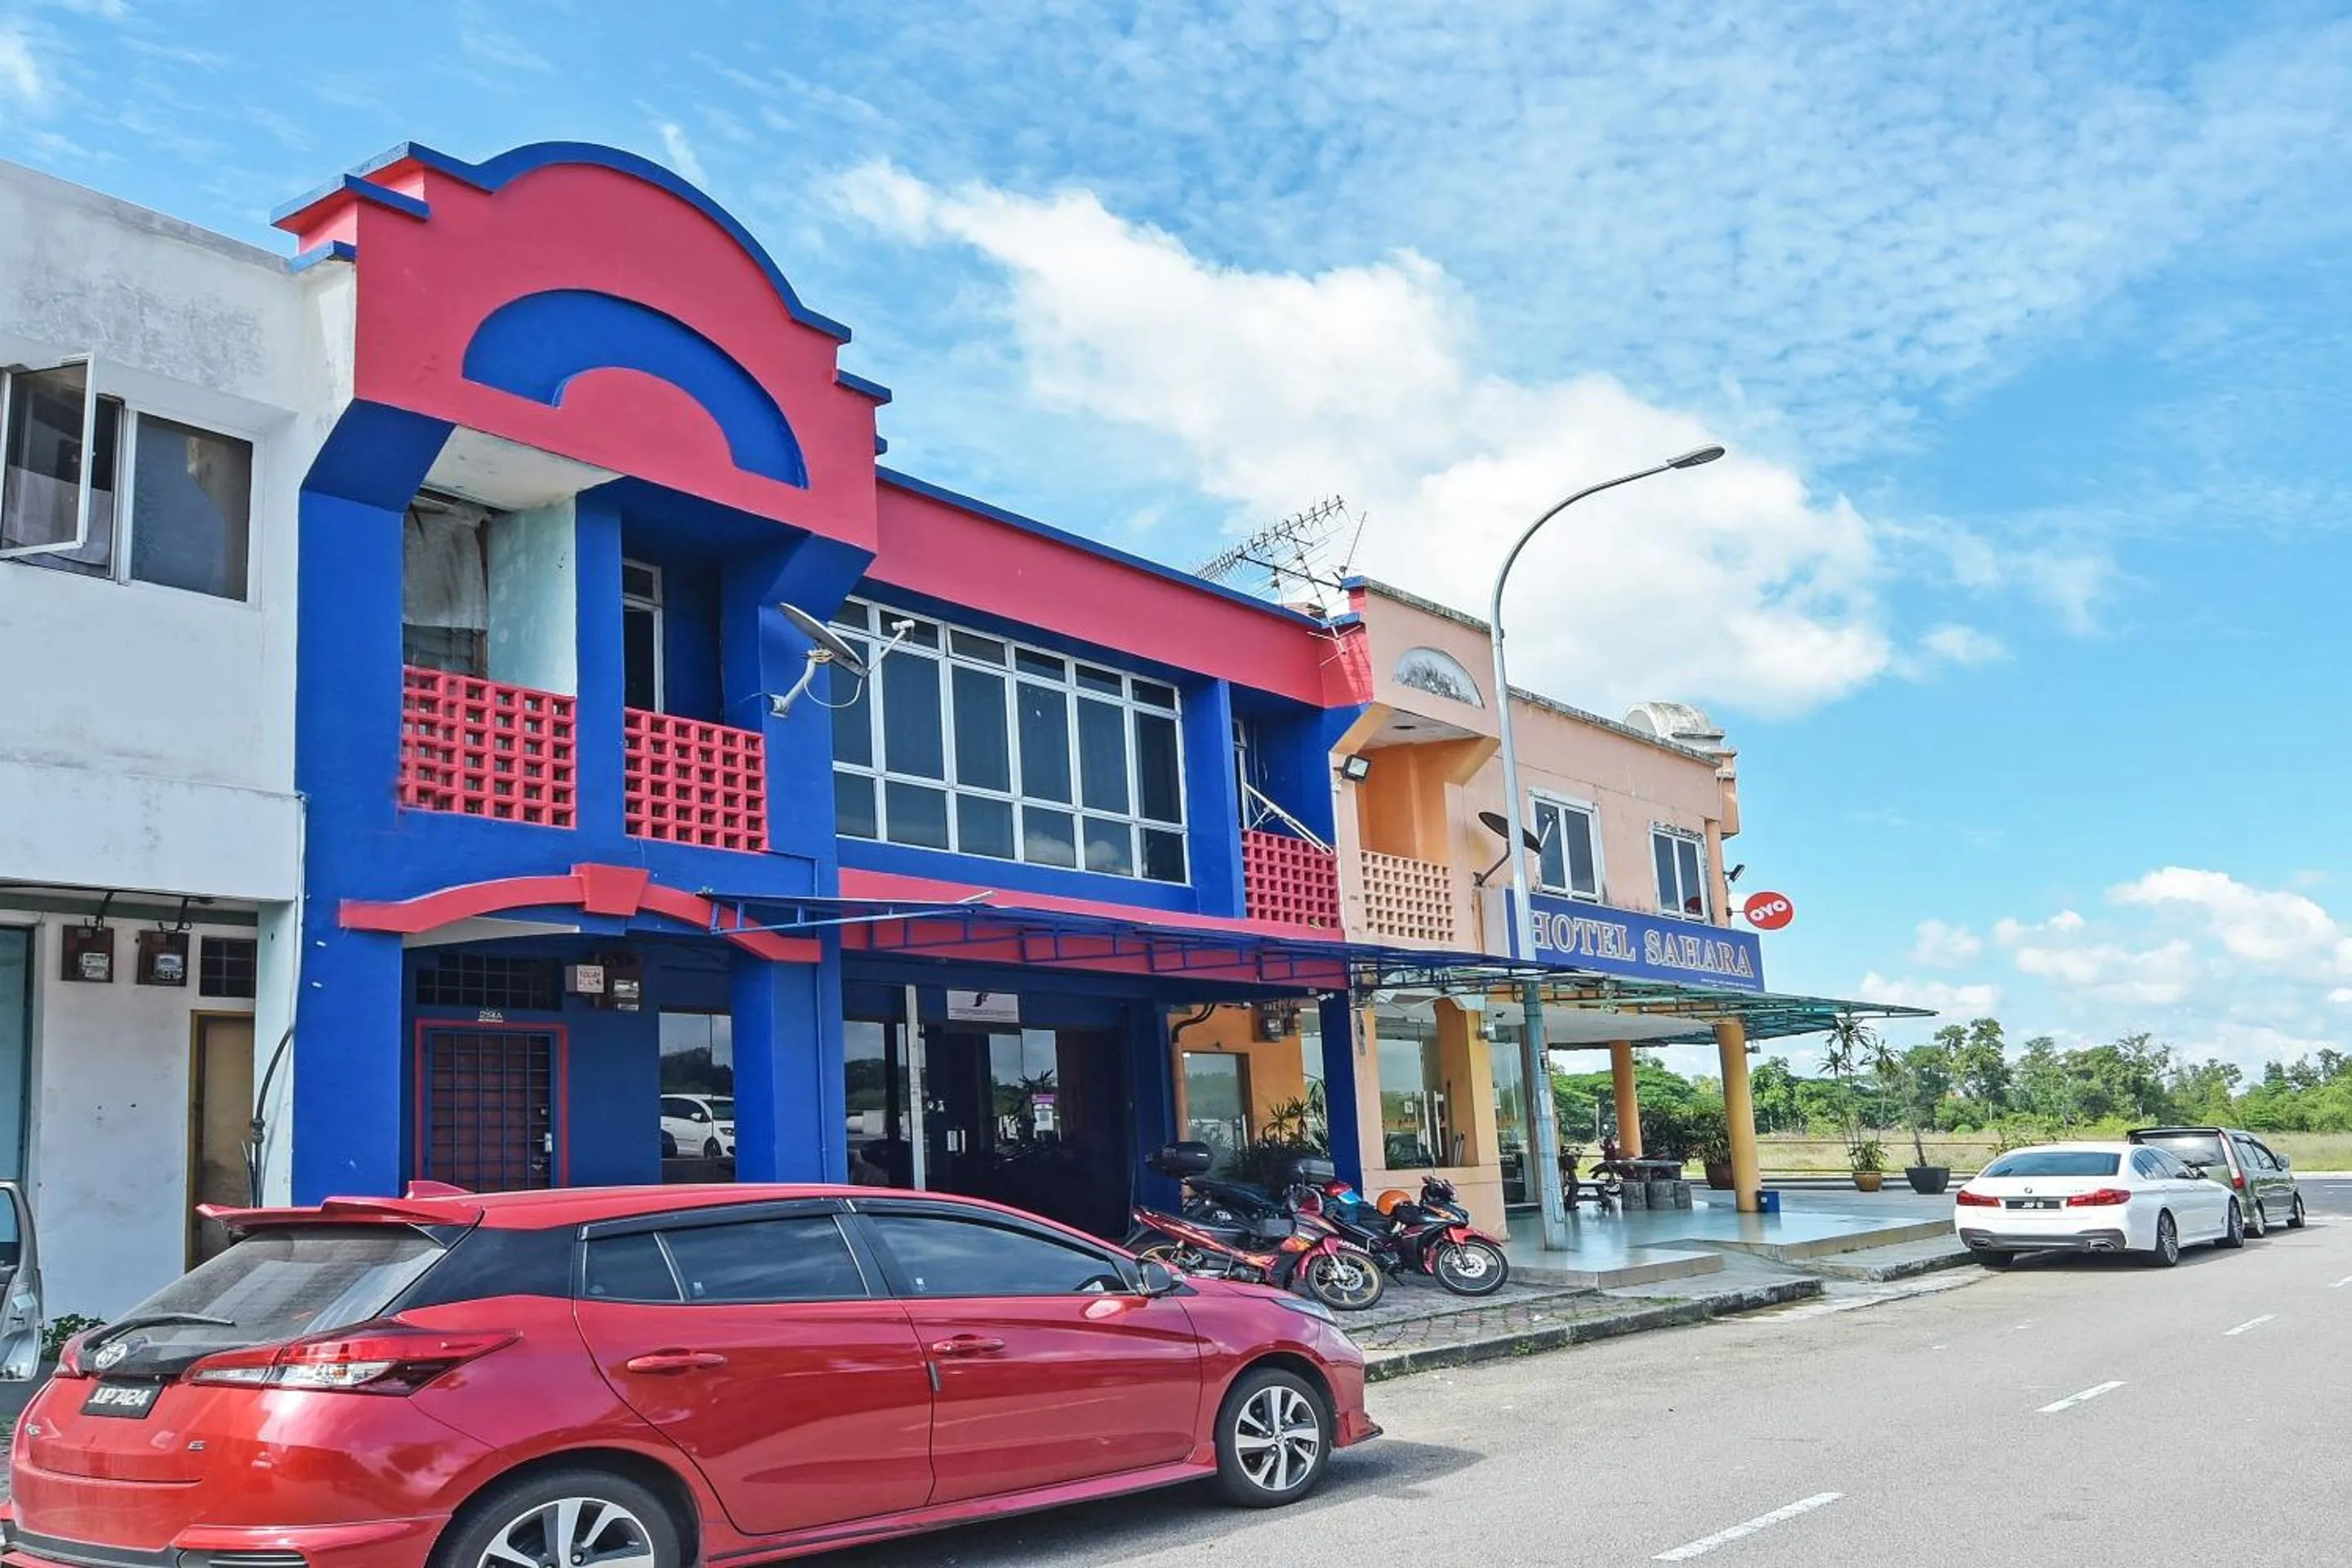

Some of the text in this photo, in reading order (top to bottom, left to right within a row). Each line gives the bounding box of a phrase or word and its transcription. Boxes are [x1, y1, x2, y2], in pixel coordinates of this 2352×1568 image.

[1749, 900, 1787, 921] OYO
[1532, 910, 1754, 978] HOTEL SAHARA
